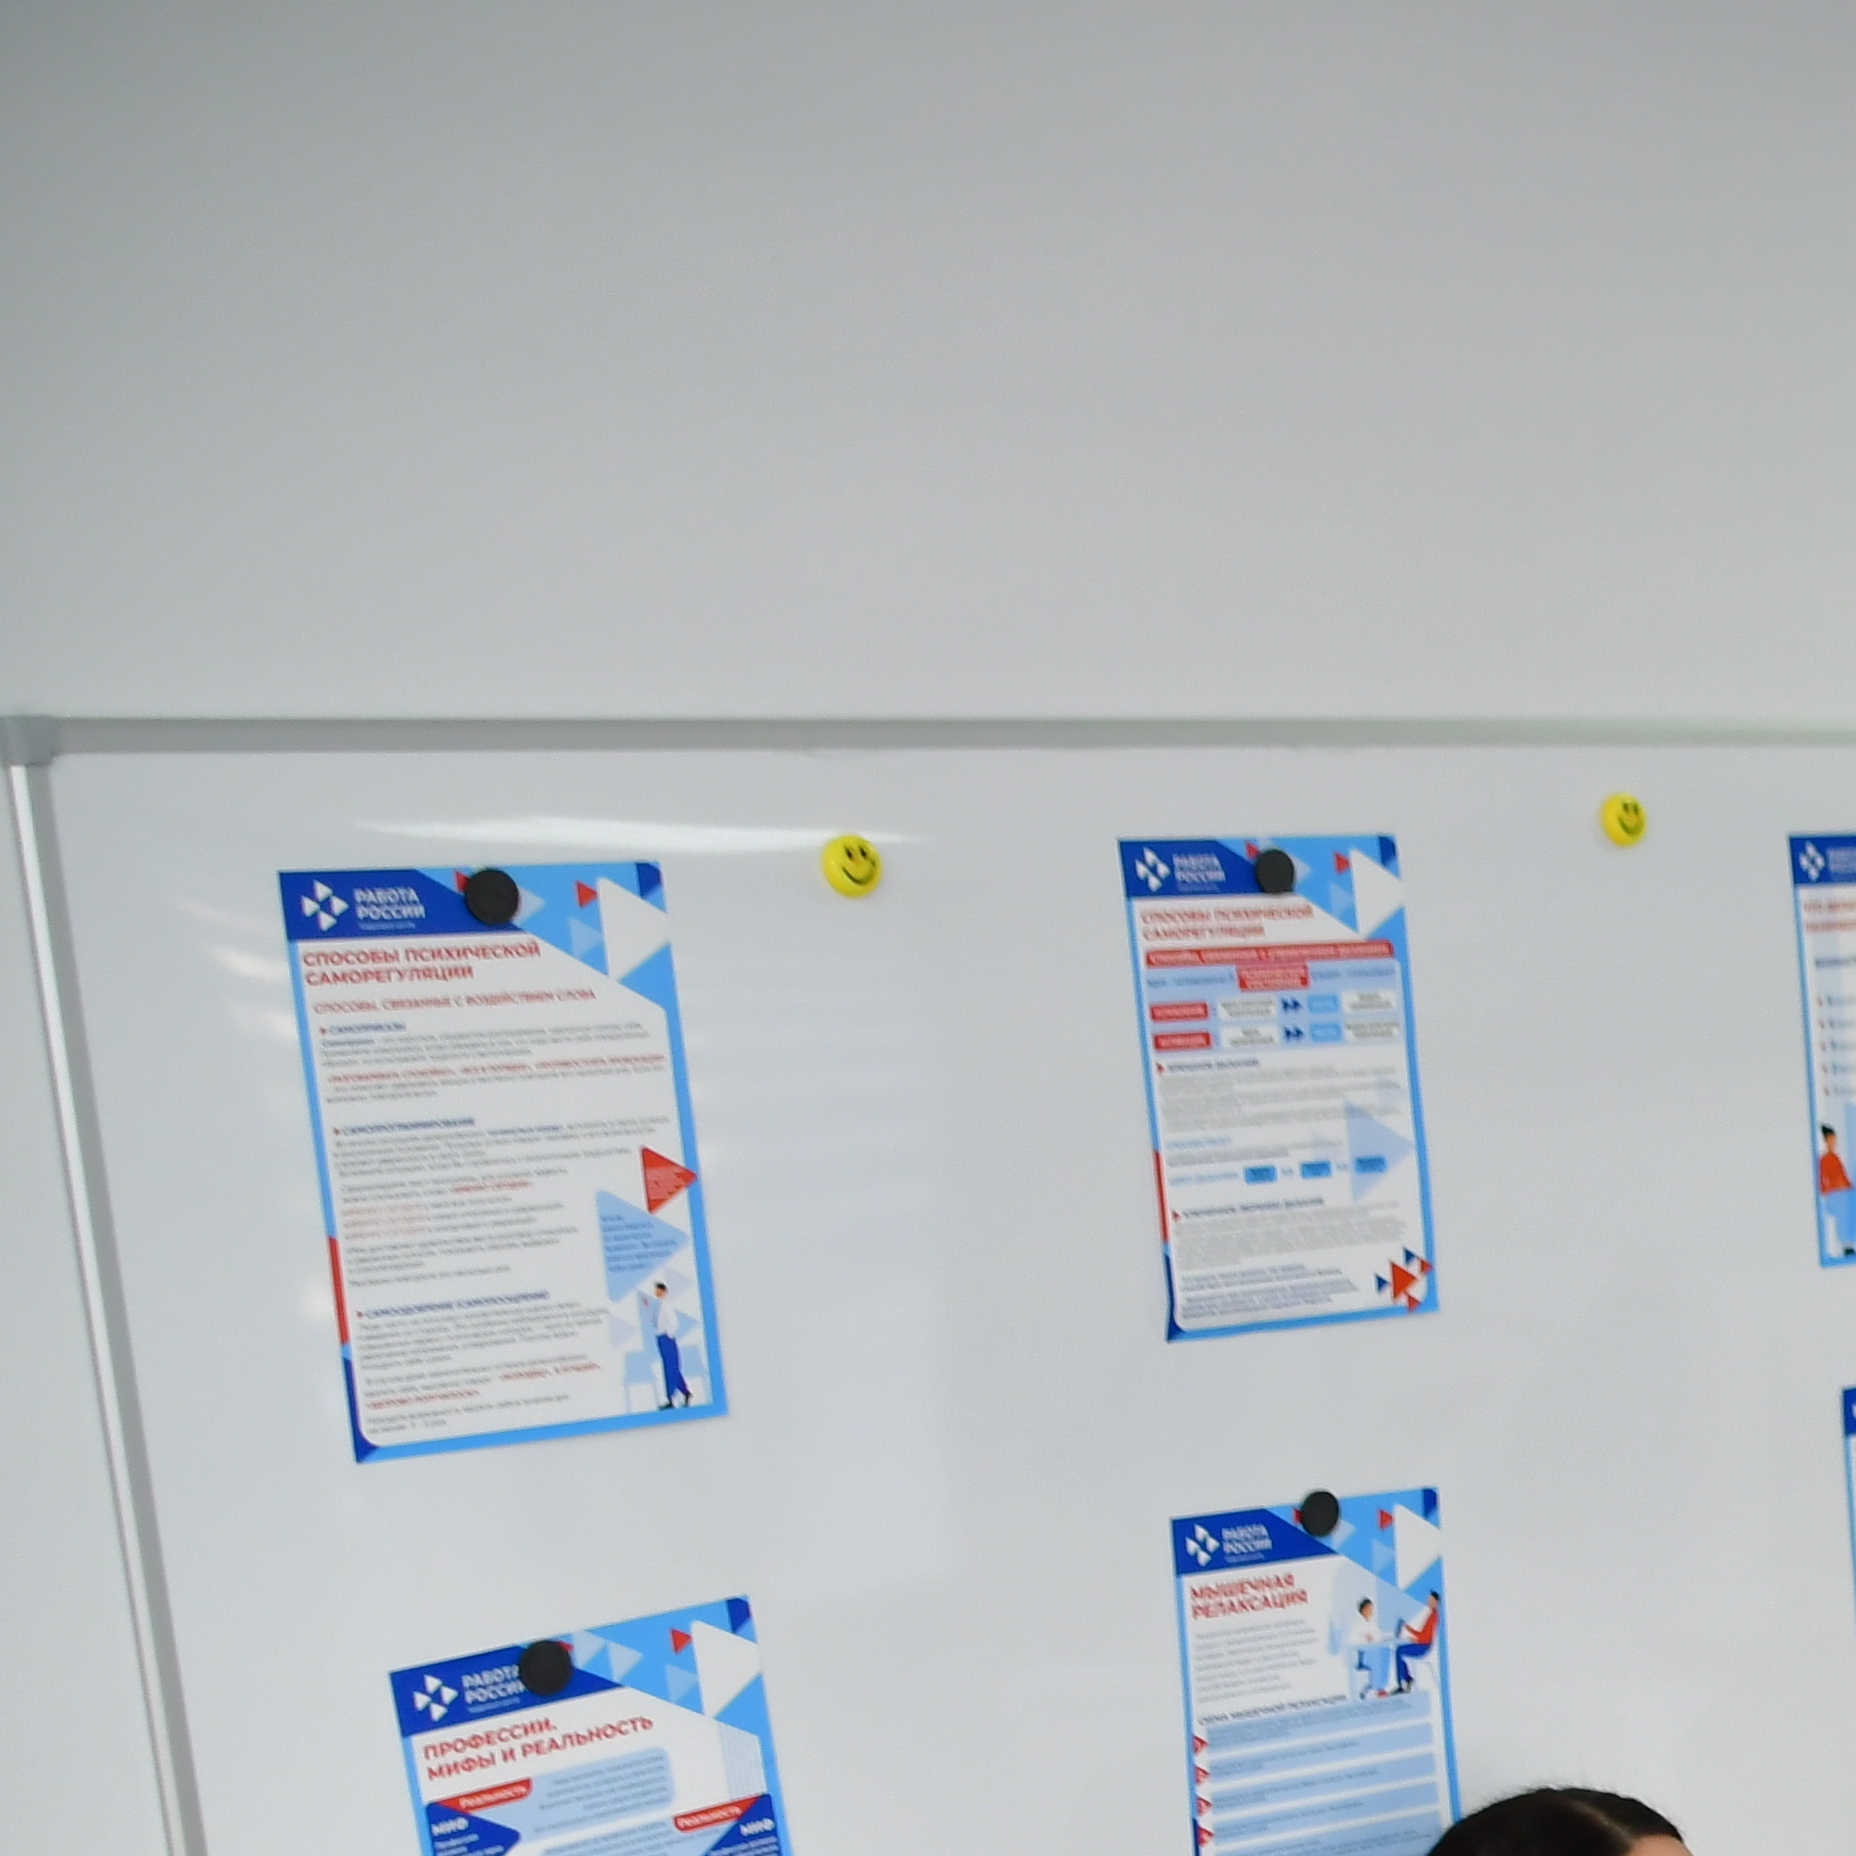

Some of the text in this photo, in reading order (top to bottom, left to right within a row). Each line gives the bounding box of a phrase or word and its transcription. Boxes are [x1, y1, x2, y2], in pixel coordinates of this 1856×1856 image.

[353, 886, 419, 905] РАБОТА
[356, 903, 426, 921] РОССИИ
[303, 937, 542, 968] СПОСОБЫ ПСИХИЧЕСКОЙ
[305, 964, 475, 987] САМОРЕГУЛЯЦИИ
[1190, 1572, 1296, 1600] МЫШЕЧНАЯ
[1191, 1589, 1310, 1619] РЕЛАКСАЦИЯ
[423, 1717, 558, 1761] ПРОФЕССИИ.
[427, 1715, 655, 1781] МИФЫ И РЕАЛЬНОСТЬ
[458, 1785, 529, 1809] Реальность
[430, 1816, 470, 1837] МИФ
[676, 1804, 743, 1829] Реальность
[739, 1816, 775, 1837] МИФ
